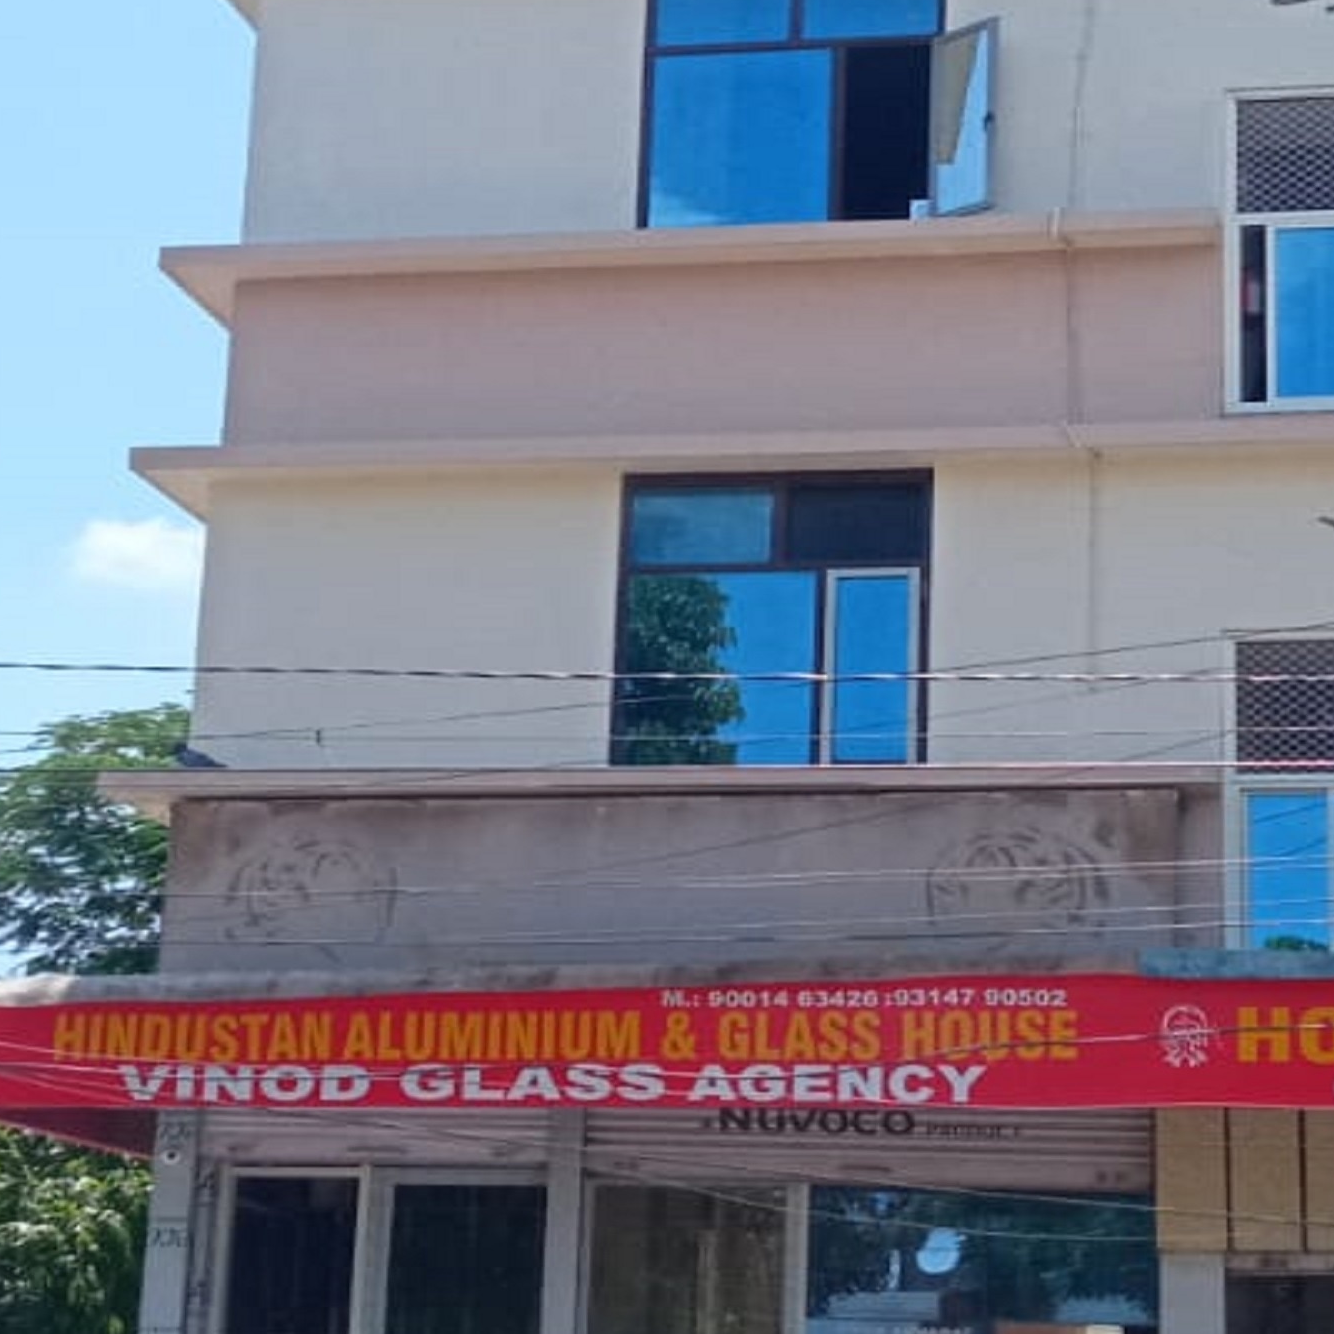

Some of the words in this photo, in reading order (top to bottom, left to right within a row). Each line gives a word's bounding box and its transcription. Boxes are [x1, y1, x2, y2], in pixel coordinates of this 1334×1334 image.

[708, 990, 788, 1007] 90014
[52, 1012, 334, 1064] HINDUSTAN
[344, 1009, 641, 1063] ALUMINIUM
[660, 1010, 696, 1061] &
[718, 1009, 881, 1062] GLASS
[903, 1008, 1079, 1061] HOUSE
[119, 1063, 369, 1104] VINOD
[399, 1063, 666, 1103] GLASS
[686, 1063, 988, 1105] AGENCY
[717, 1107, 917, 1137] NUVOCO
